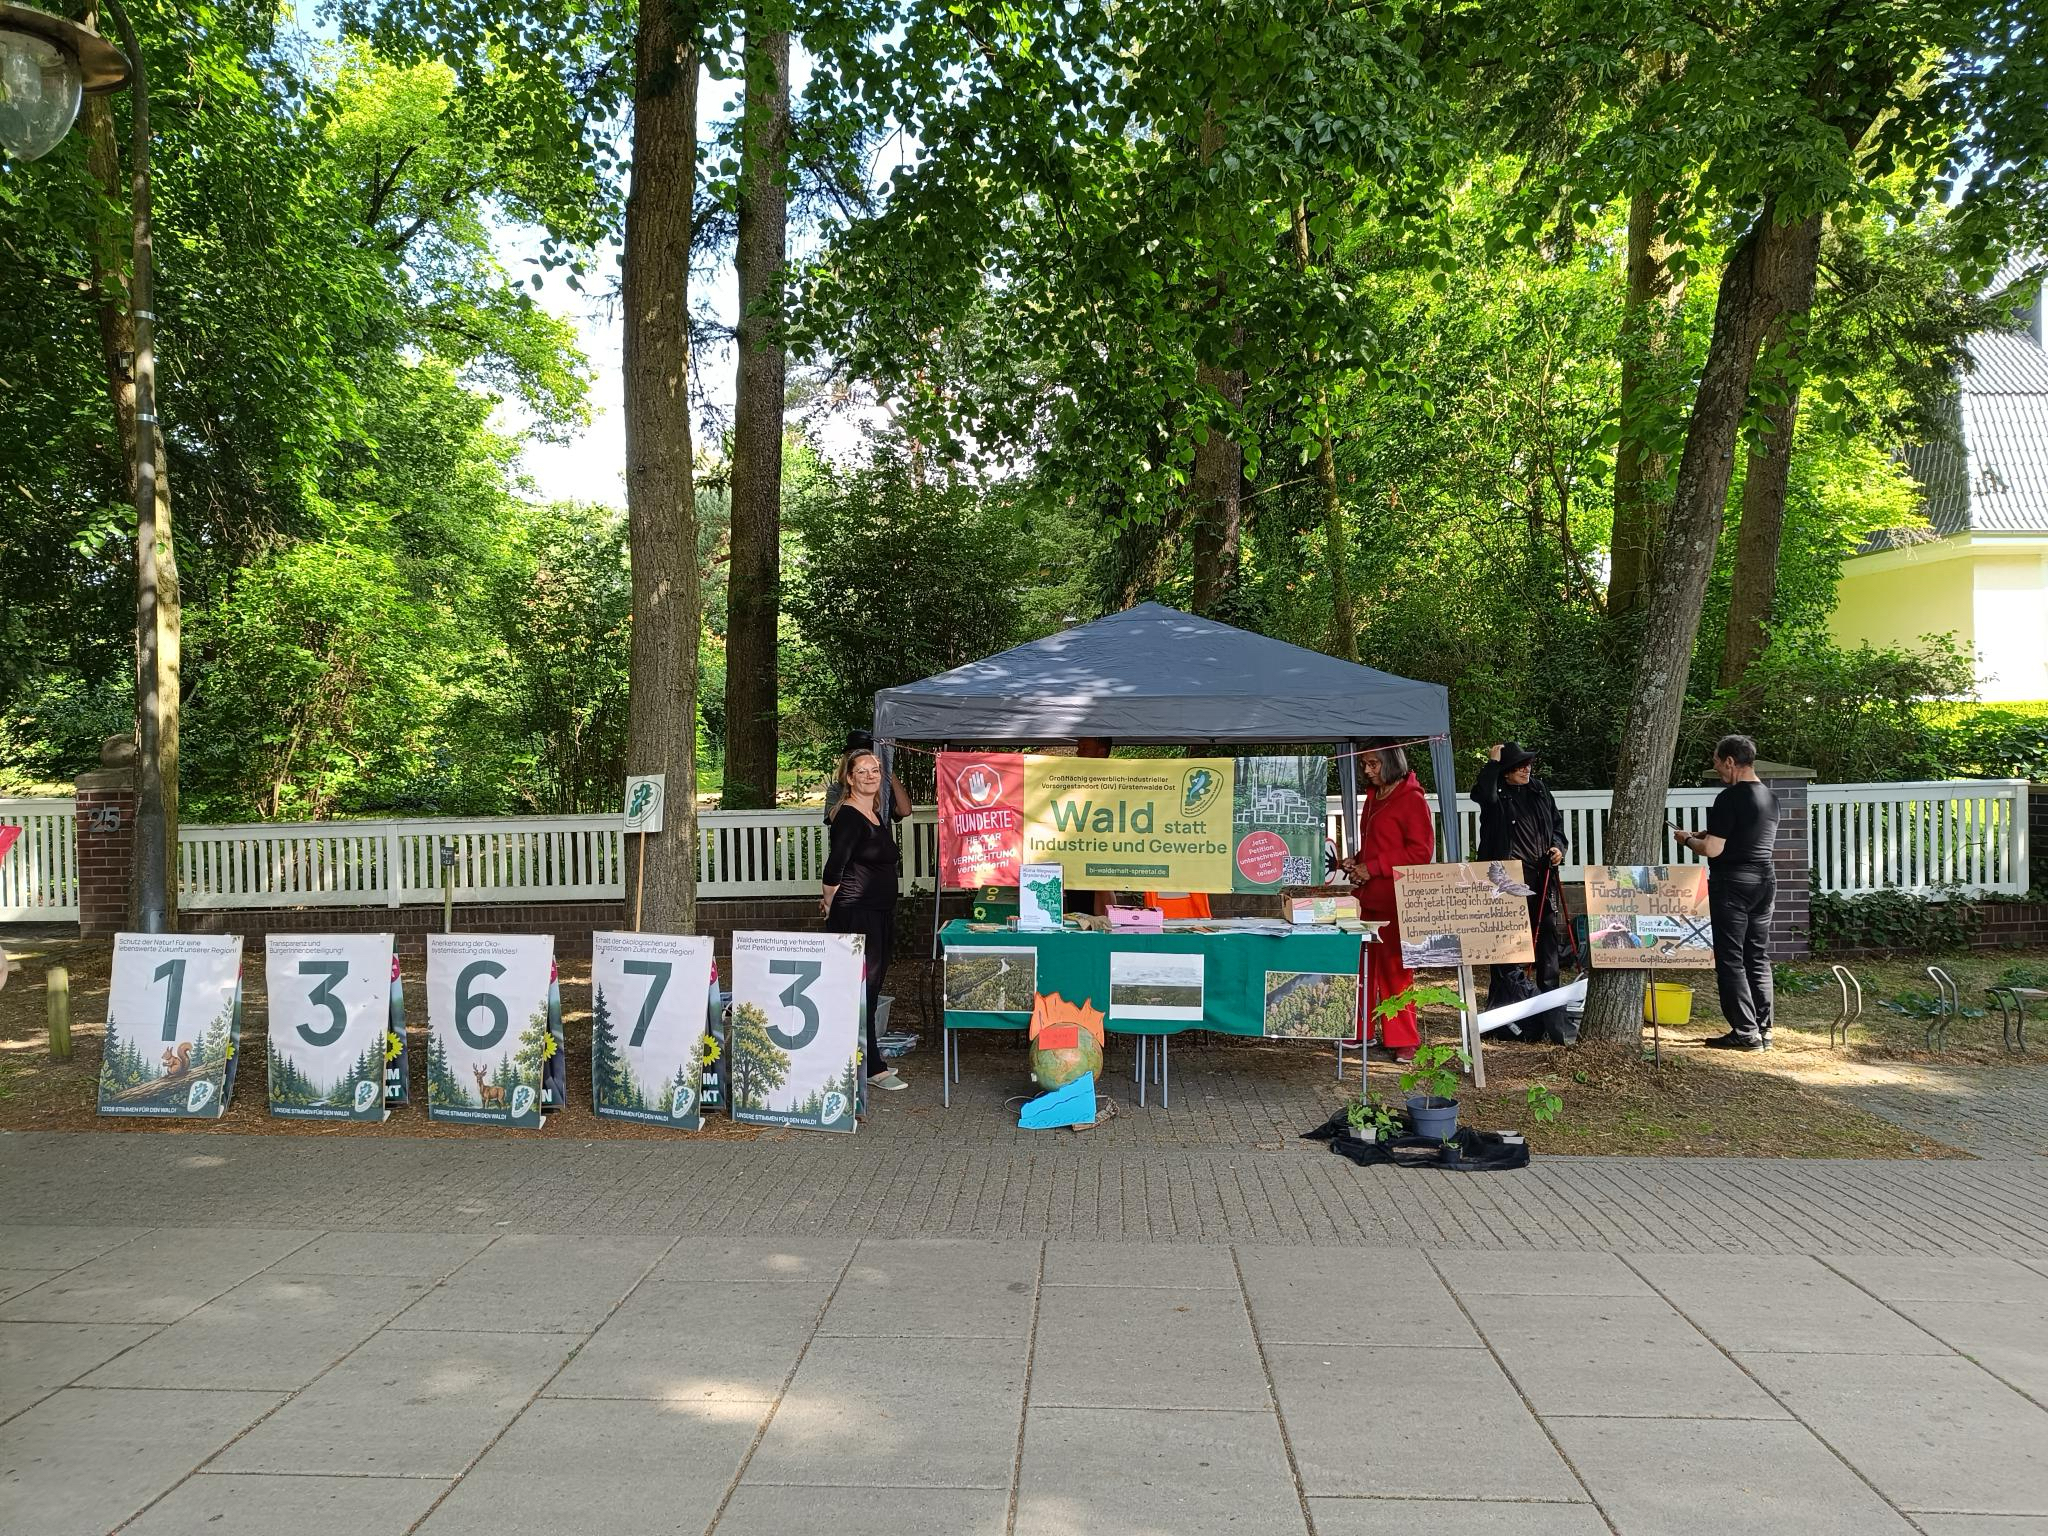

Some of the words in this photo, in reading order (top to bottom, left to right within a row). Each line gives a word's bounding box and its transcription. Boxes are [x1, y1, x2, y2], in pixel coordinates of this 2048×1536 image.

[1049, 775, 1088, 784] Großflächig
[1089, 775, 1169, 784] gewerblich-industrieller
[1041, 782, 1099, 792] Vorsorgestandort
[1118, 783, 1163, 791] Fürstenwalde
[88, 806, 120, 832] 25
[955, 810, 1012, 835] HUNDERTE
[1050, 799, 1154, 834] Wald
[1164, 820, 1207, 834] statt
[966, 832, 1002, 845] HEKTAR
[1251, 838, 1268, 847] Jetzt
[968, 842, 998, 854] WALD-
[1030, 837, 1108, 852] Industrie
[1112, 839, 1145, 853] und
[1149, 839, 1227, 855] Gewerbe
[1248, 845, 1275, 855] Petition
[953, 849, 1016, 866] VERNICHTUNG
[1240, 850, 1288, 865] unterschreiben
[957, 859, 1009, 874] verhindern!
[1089, 867, 1166, 876] bi-walderhalt-spreetal.de
[1256, 867, 1278, 877] teilen!
[1406, 868, 1444, 883] Hymne
[1425, 887, 1439, 895] war
[1441, 884, 1453, 895] ich
[1455, 885, 1470, 894] euer
[1658, 883, 1692, 898] Keine
[1405, 897, 1423, 908] doch
[1424, 897, 1446, 910] jetzt
[1469, 895, 1482, 906] ich
[1606, 899, 1639, 913] walde
[1401, 910, 1413, 924] Wo
[1413, 911, 1430, 923] sind
[1431, 909, 1468, 926] geblieben
[1469, 910, 1490, 920] meine
[1490, 906, 1518, 919] Wälder
[1407, 925, 1418, 938] Ich
[1418, 927, 1431, 937] mag
[1431, 923, 1453, 935] nicht
[1456, 924, 1480, 934] euren
[1480, 920, 1529, 934] Stahlbeton!
[269, 940, 307, 948] Transparenz
[431, 939, 472, 948] Anerkennung
[622, 939, 663, 947] ökologischen
[736, 936, 788, 945] Waldvernichtung
[431, 946, 478, 955] systemleistung
[478, 947, 491, 955] des
[491, 947, 518, 955] Waldes!
[595, 944, 632, 953] touristischen
[670, 948, 695, 956] Region!
[751, 944, 776, 952] Petition
[776, 945, 826, 953] unterschreiben!
[153, 959, 187, 1042] 1
[296, 960, 350, 1047] 3
[455, 960, 509, 1050] 6
[623, 959, 673, 1047] 7
[765, 959, 822, 1050] 3
[599, 1107, 615, 1115] UNSERE
[615, 1109, 636, 1117] STIMMEN
[636, 1110, 644, 1119] FÜR
[736, 1112, 755, 1120] UNSERE
[755, 1114, 778, 1122] STIMMEN
[778, 1115, 789, 1123] FÜR
